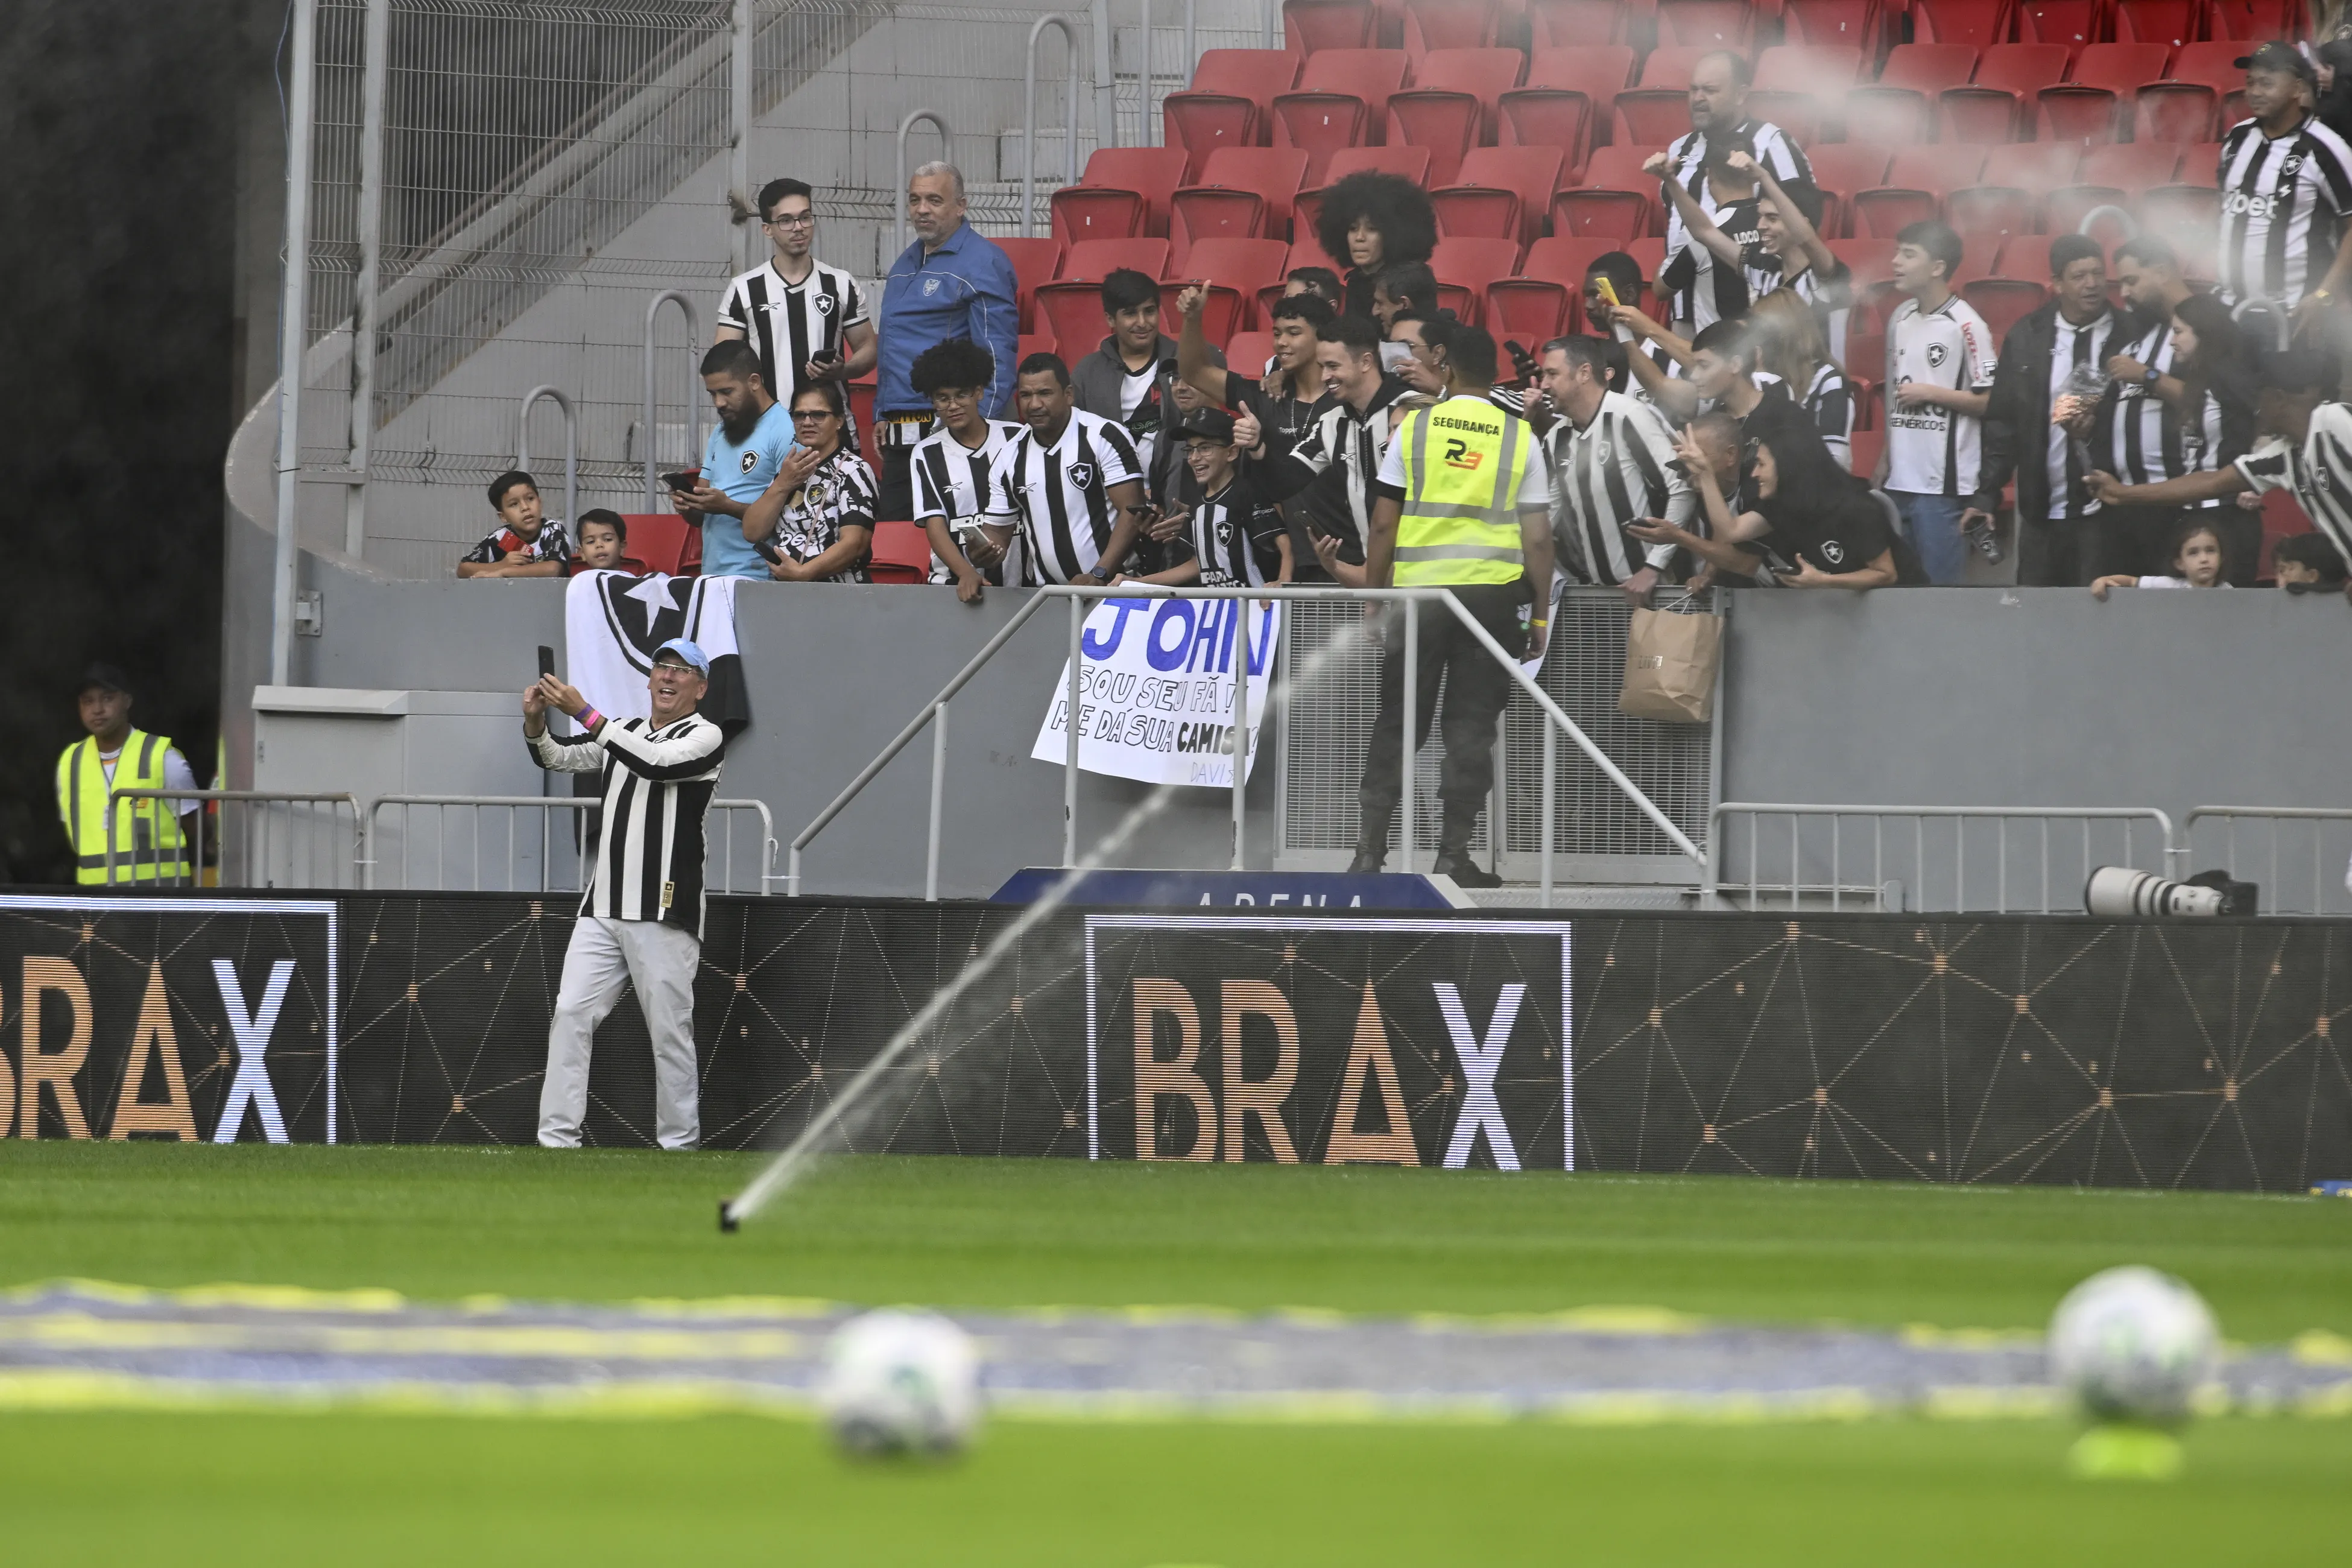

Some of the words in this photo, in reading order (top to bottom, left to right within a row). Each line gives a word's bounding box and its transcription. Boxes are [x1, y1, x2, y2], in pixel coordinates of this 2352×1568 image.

[1432, 416, 1500, 436] SEGURANÇA
[1082, 598, 1274, 677] JOHN
[1067, 665, 1137, 704] SOU
[1136, 677, 1189, 712] SEU
[1051, 700, 1096, 737] ME
[1094, 707, 1133, 743] DÁ
[1124, 715, 1175, 753] SUA
[1190, 762, 1225, 784] DAVI
[0, 955, 297, 1145] RAX
[1133, 978, 1529, 1172] BRAX
